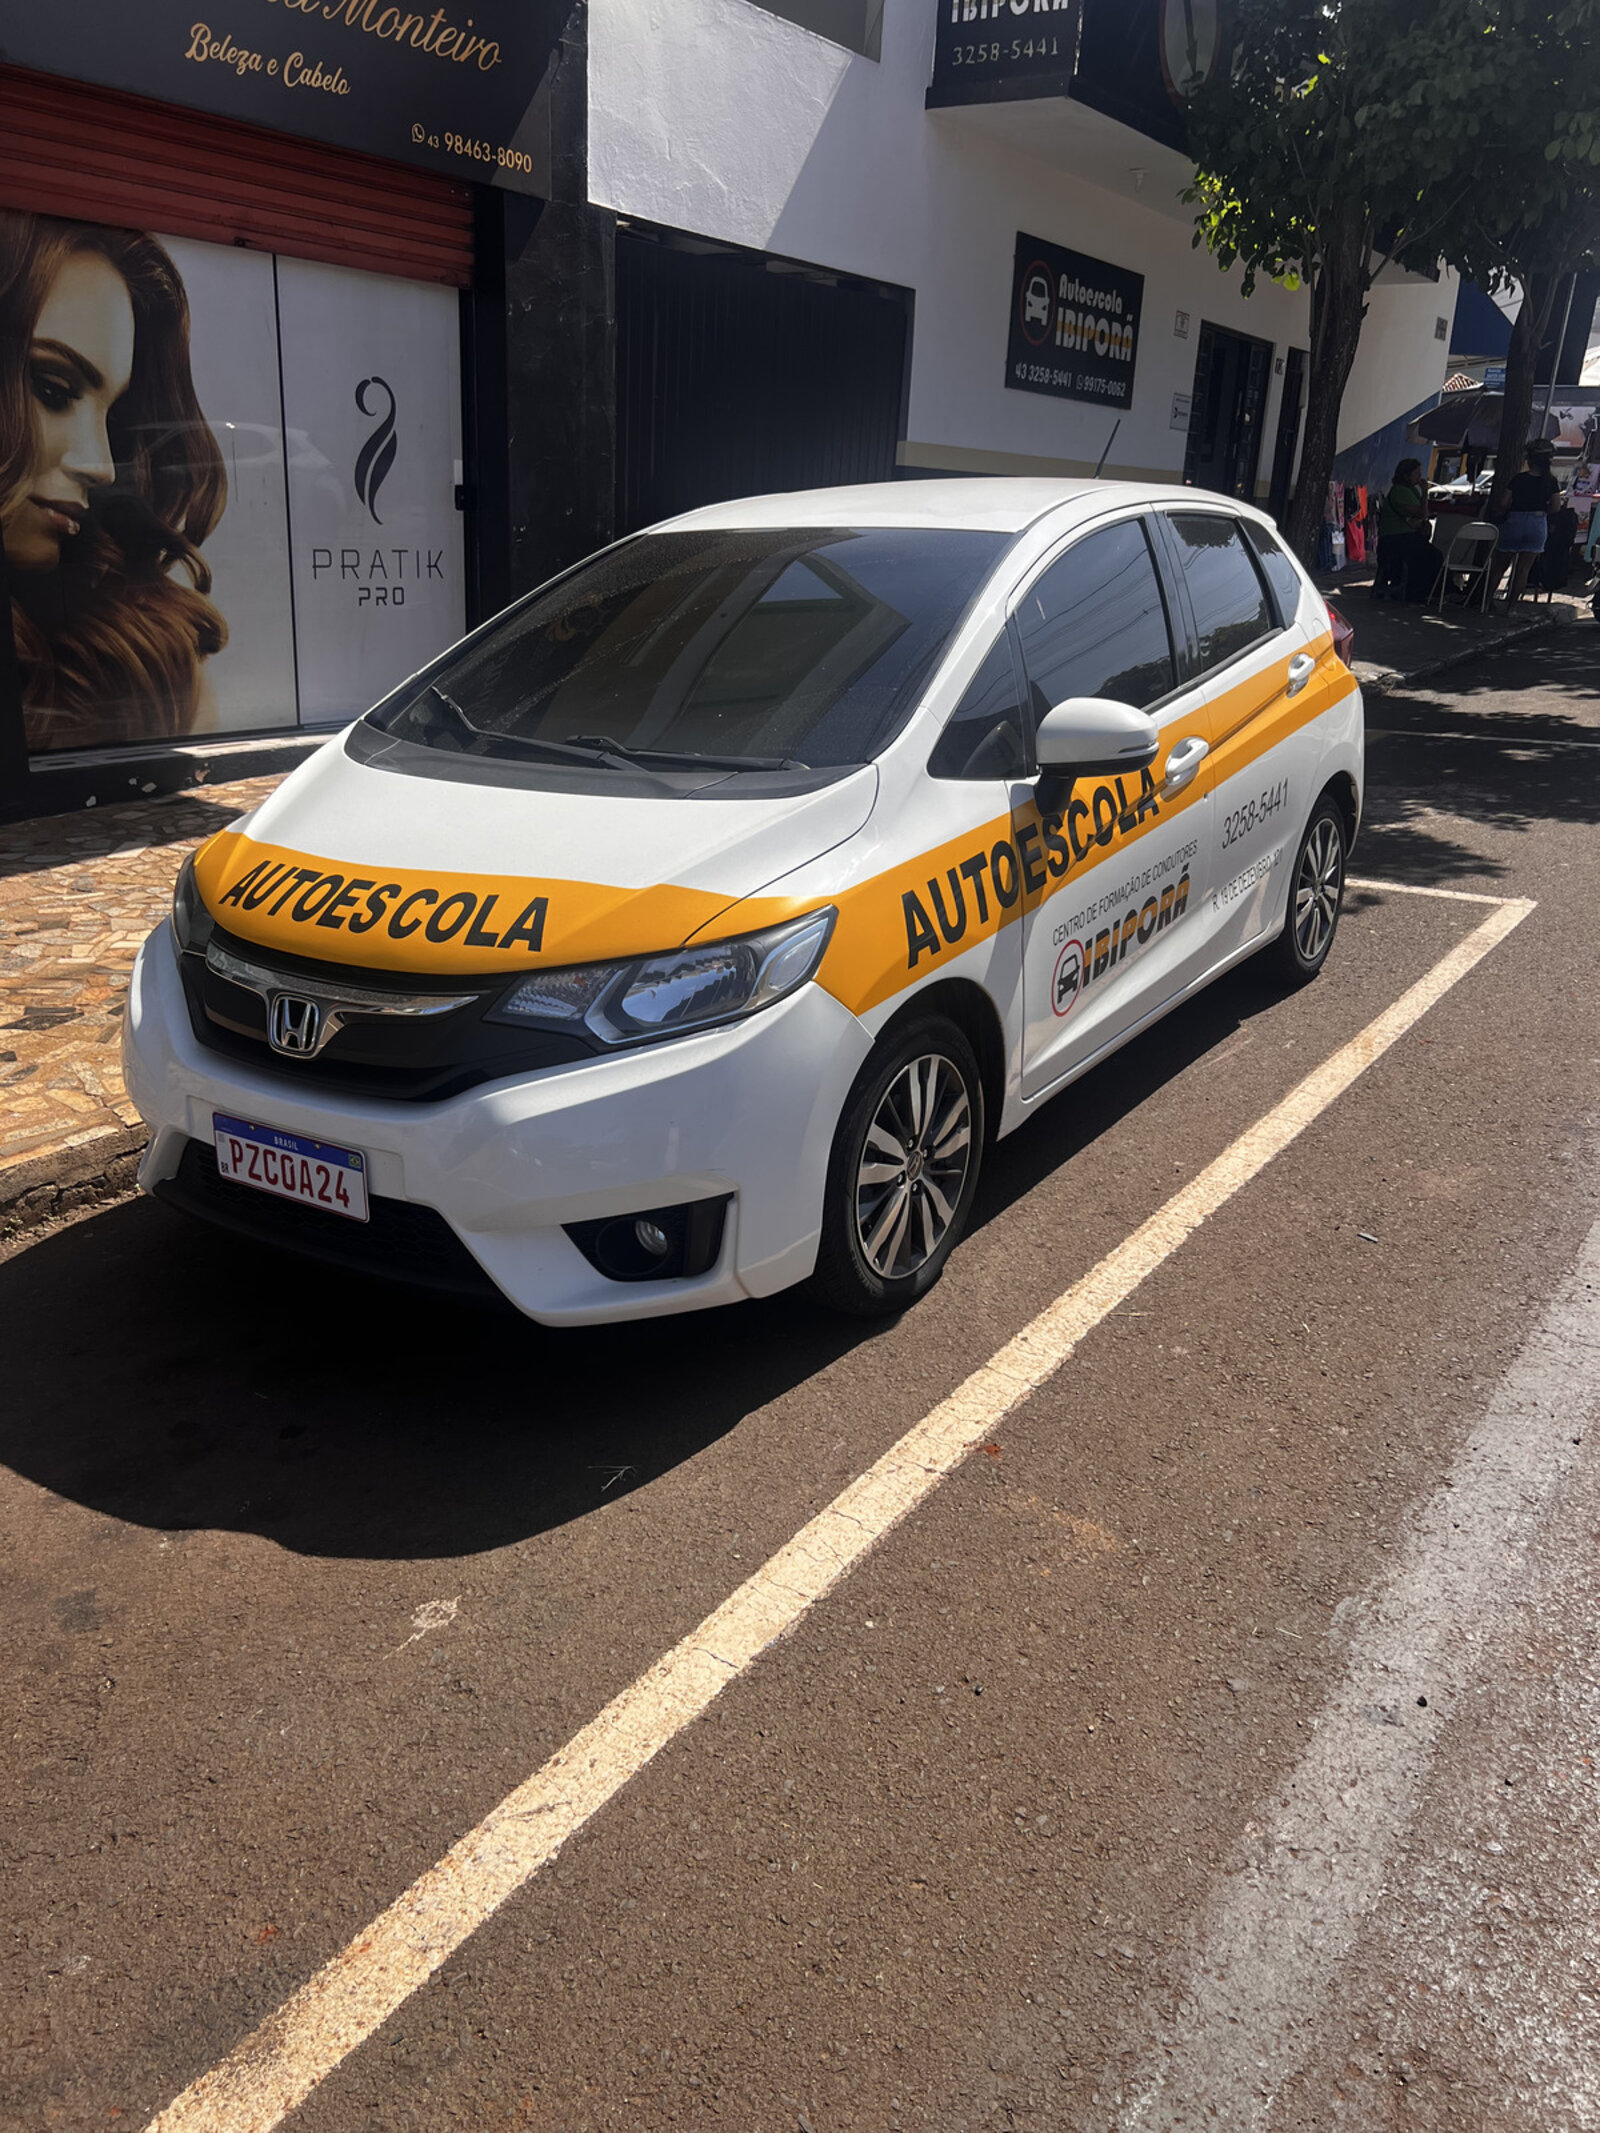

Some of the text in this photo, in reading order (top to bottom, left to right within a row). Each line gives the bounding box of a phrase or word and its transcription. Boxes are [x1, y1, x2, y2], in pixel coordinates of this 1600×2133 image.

[322, 0, 501, 71] Monteiro
[951, 37, 1059, 66] 3258-5441
[184, 22, 351, 95] Beleza e Cabelo
[427, 131, 533, 174] 43 98463-8090
[1058, 273, 1123, 314] Autoescola
[1015, 362, 1027, 380] 43
[1028, 364, 1073, 388] 3258-5441
[312, 549, 444, 580] PRATIK
[358, 587, 405, 607] PRO
[1222, 777, 1289, 849] 3258-5441
[900, 767, 1161, 970] AUTOESCOLA
[218, 859, 550, 953] AUTOESCOLA
[1052, 839, 1199, 946] CENTRO DE FORMAÇÃO DE CONDUTORES
[274, 1135, 298, 1151] BRASIL
